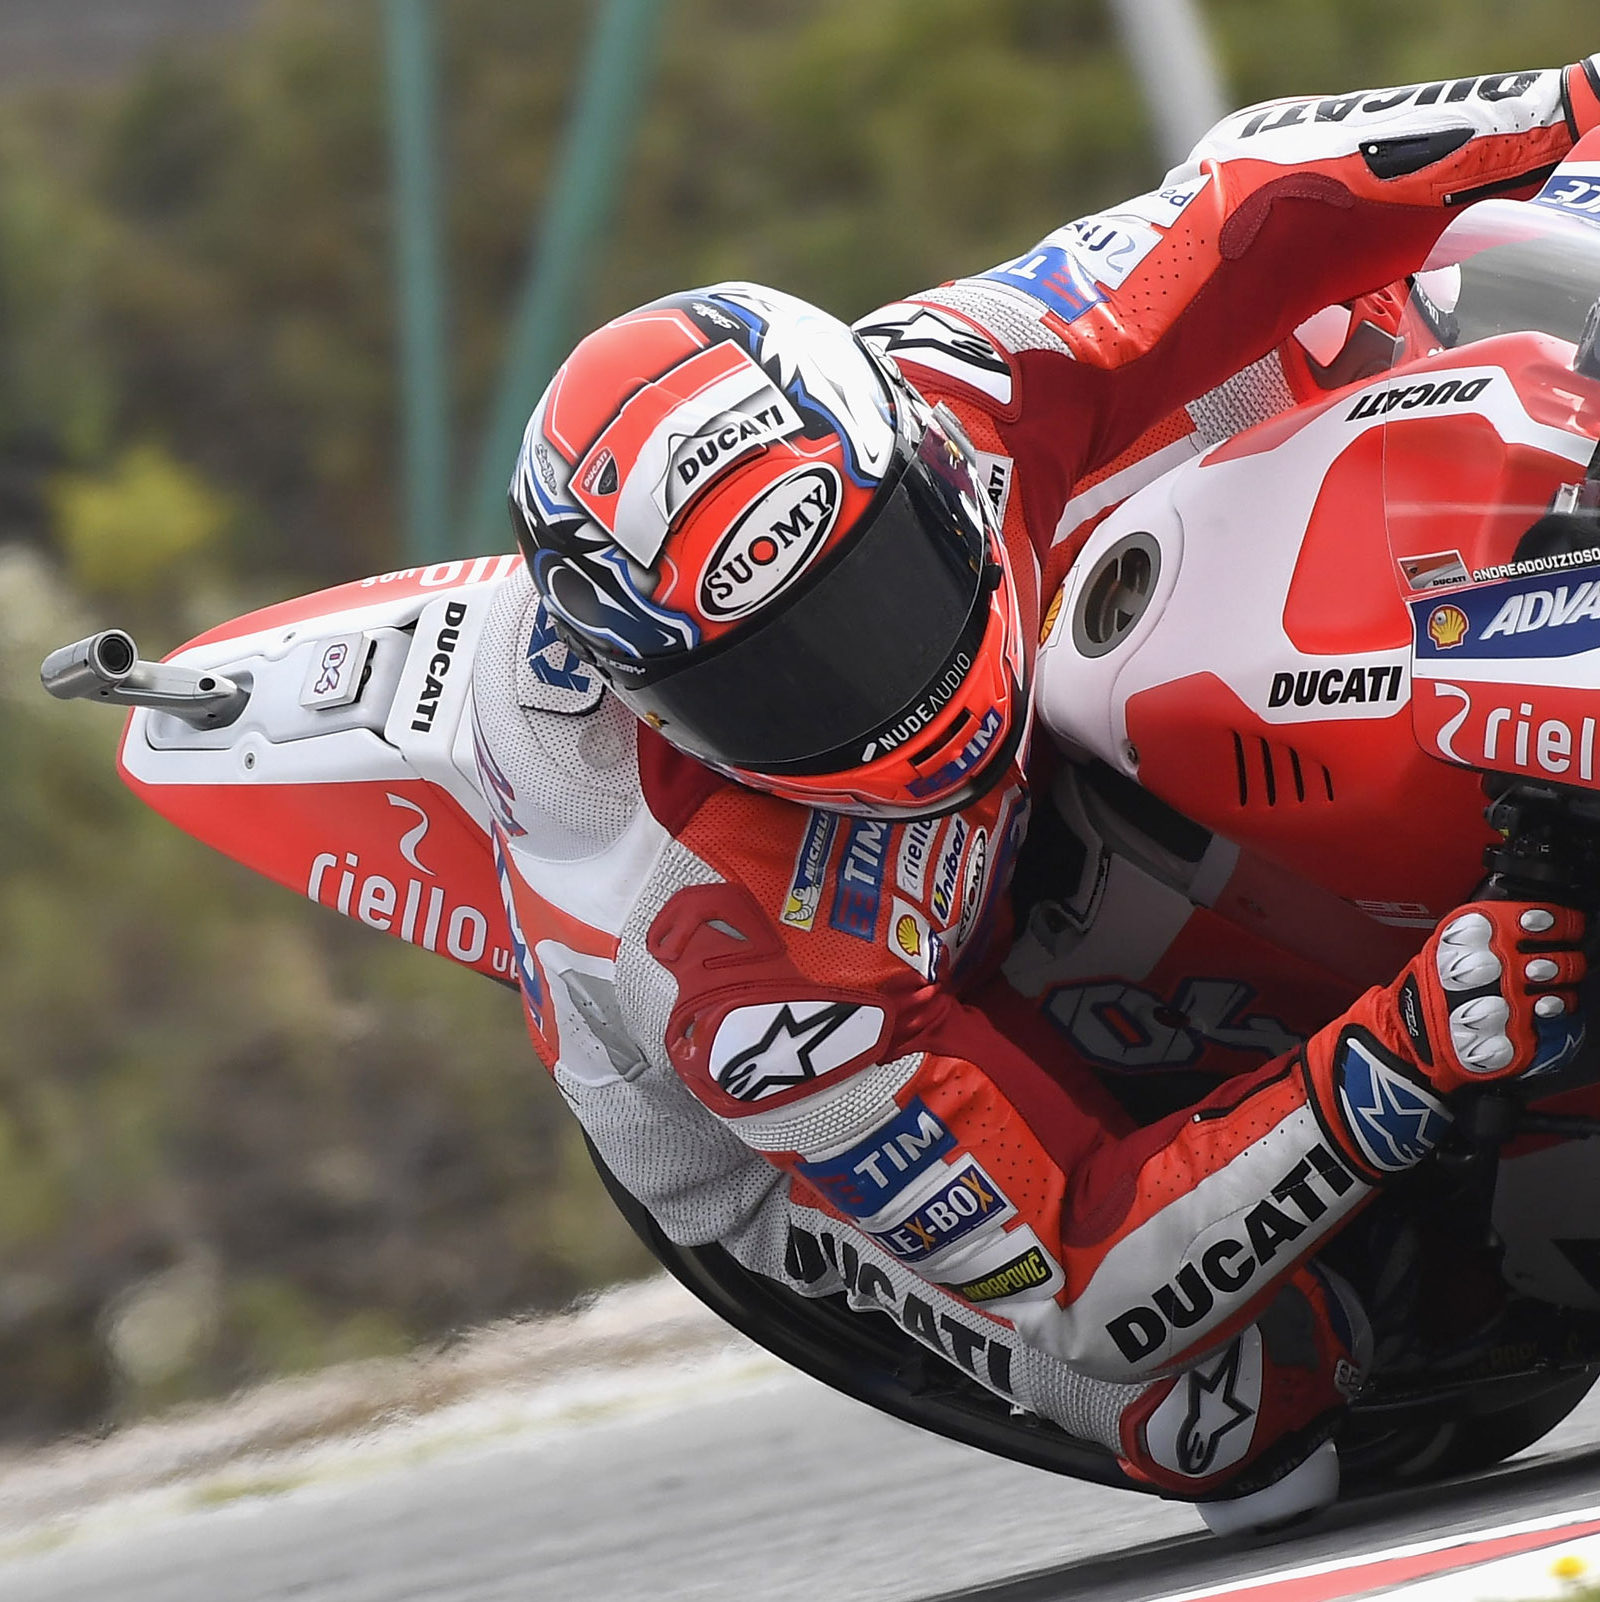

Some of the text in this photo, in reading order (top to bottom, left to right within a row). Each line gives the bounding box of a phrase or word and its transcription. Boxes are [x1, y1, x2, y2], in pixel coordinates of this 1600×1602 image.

[1345, 377, 1494, 423] DUCATI
[677, 404, 785, 487] DUCATI
[704, 483, 834, 601] SUOMY
[1432, 575, 1467, 588] DUCATI
[410, 601, 467, 734] DUCATI
[1267, 665, 1404, 709] DUCATI
[951, 713, 1001, 773] TIM
[844, 817, 888, 887] TIM
[933, 818, 967, 921] Unibat
[307, 852, 488, 964] riello
[853, 1108, 945, 1192] TIM
[882, 1168, 998, 1258] LEX-BOX
[1105, 1142, 1355, 1364] DUCATI
[786, 1224, 1013, 1393] DUCATI
